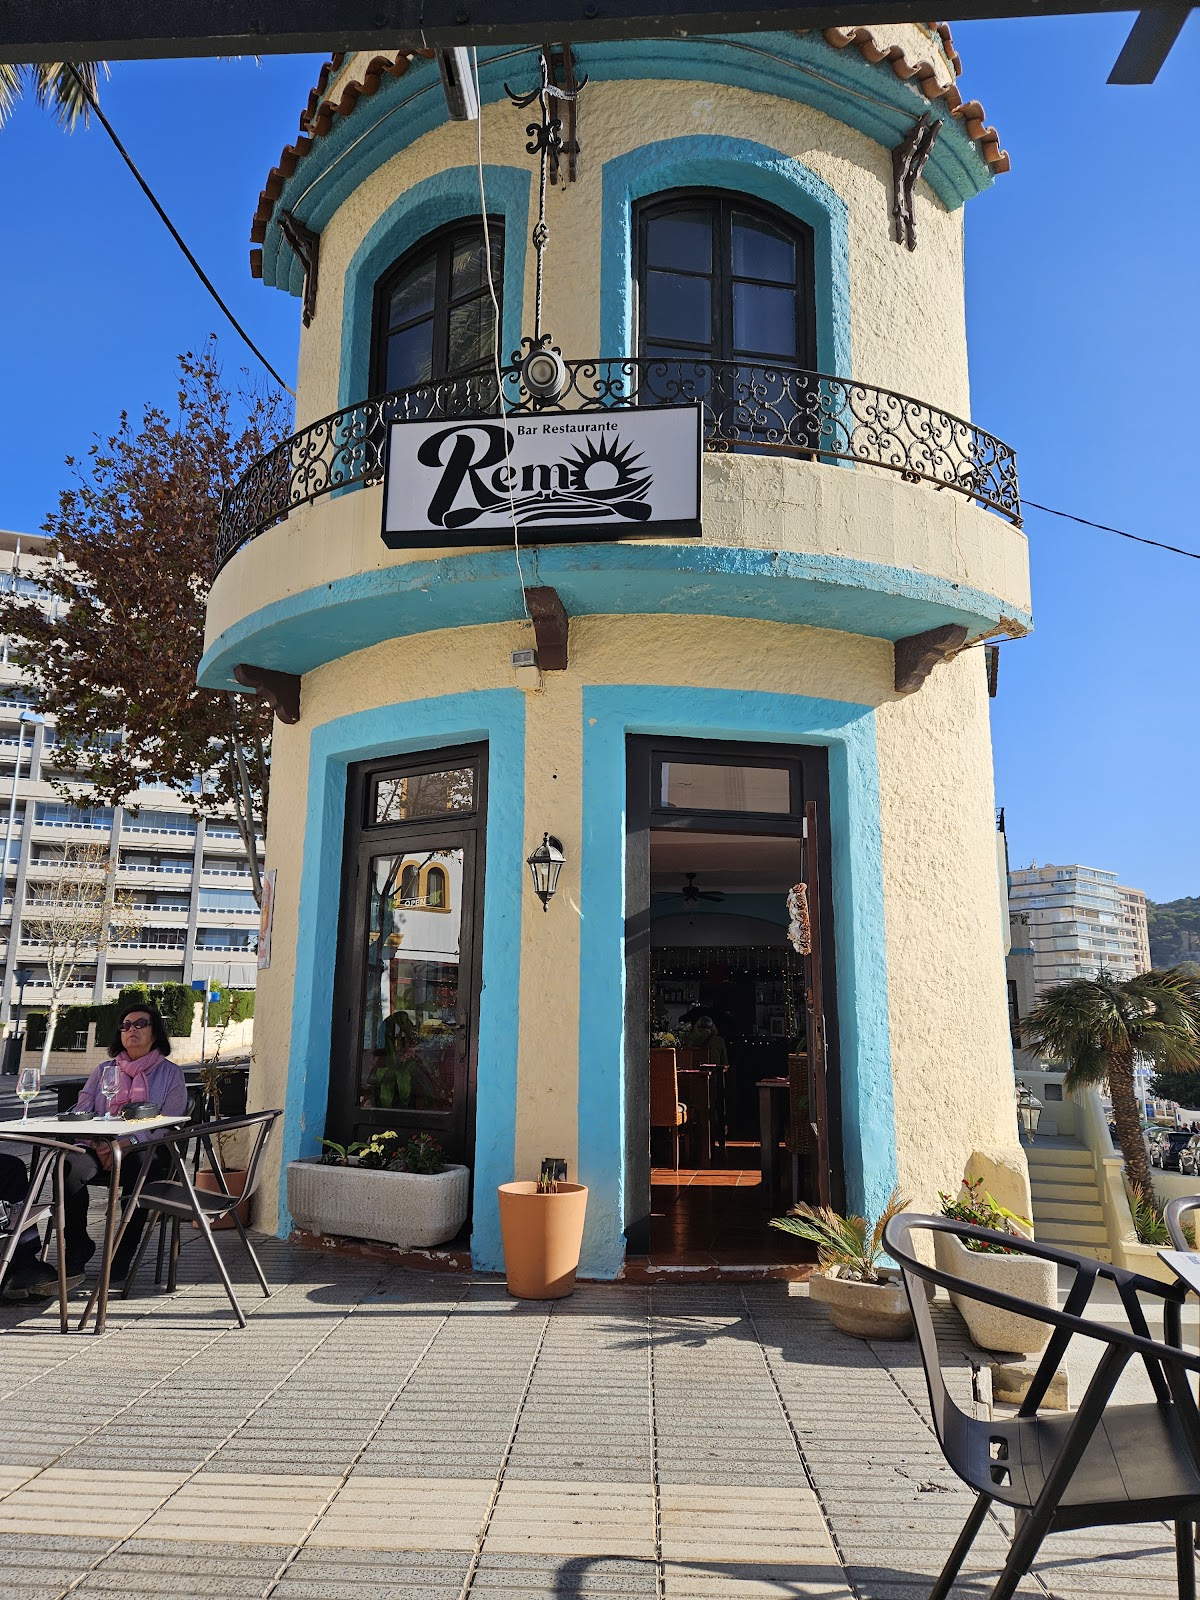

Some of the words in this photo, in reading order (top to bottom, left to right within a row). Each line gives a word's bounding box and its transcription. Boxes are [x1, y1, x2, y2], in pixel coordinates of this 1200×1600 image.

[517, 425, 538, 435] Bar
[542, 421, 618, 434] Restaurante
[404, 897, 426, 907] OPEN
